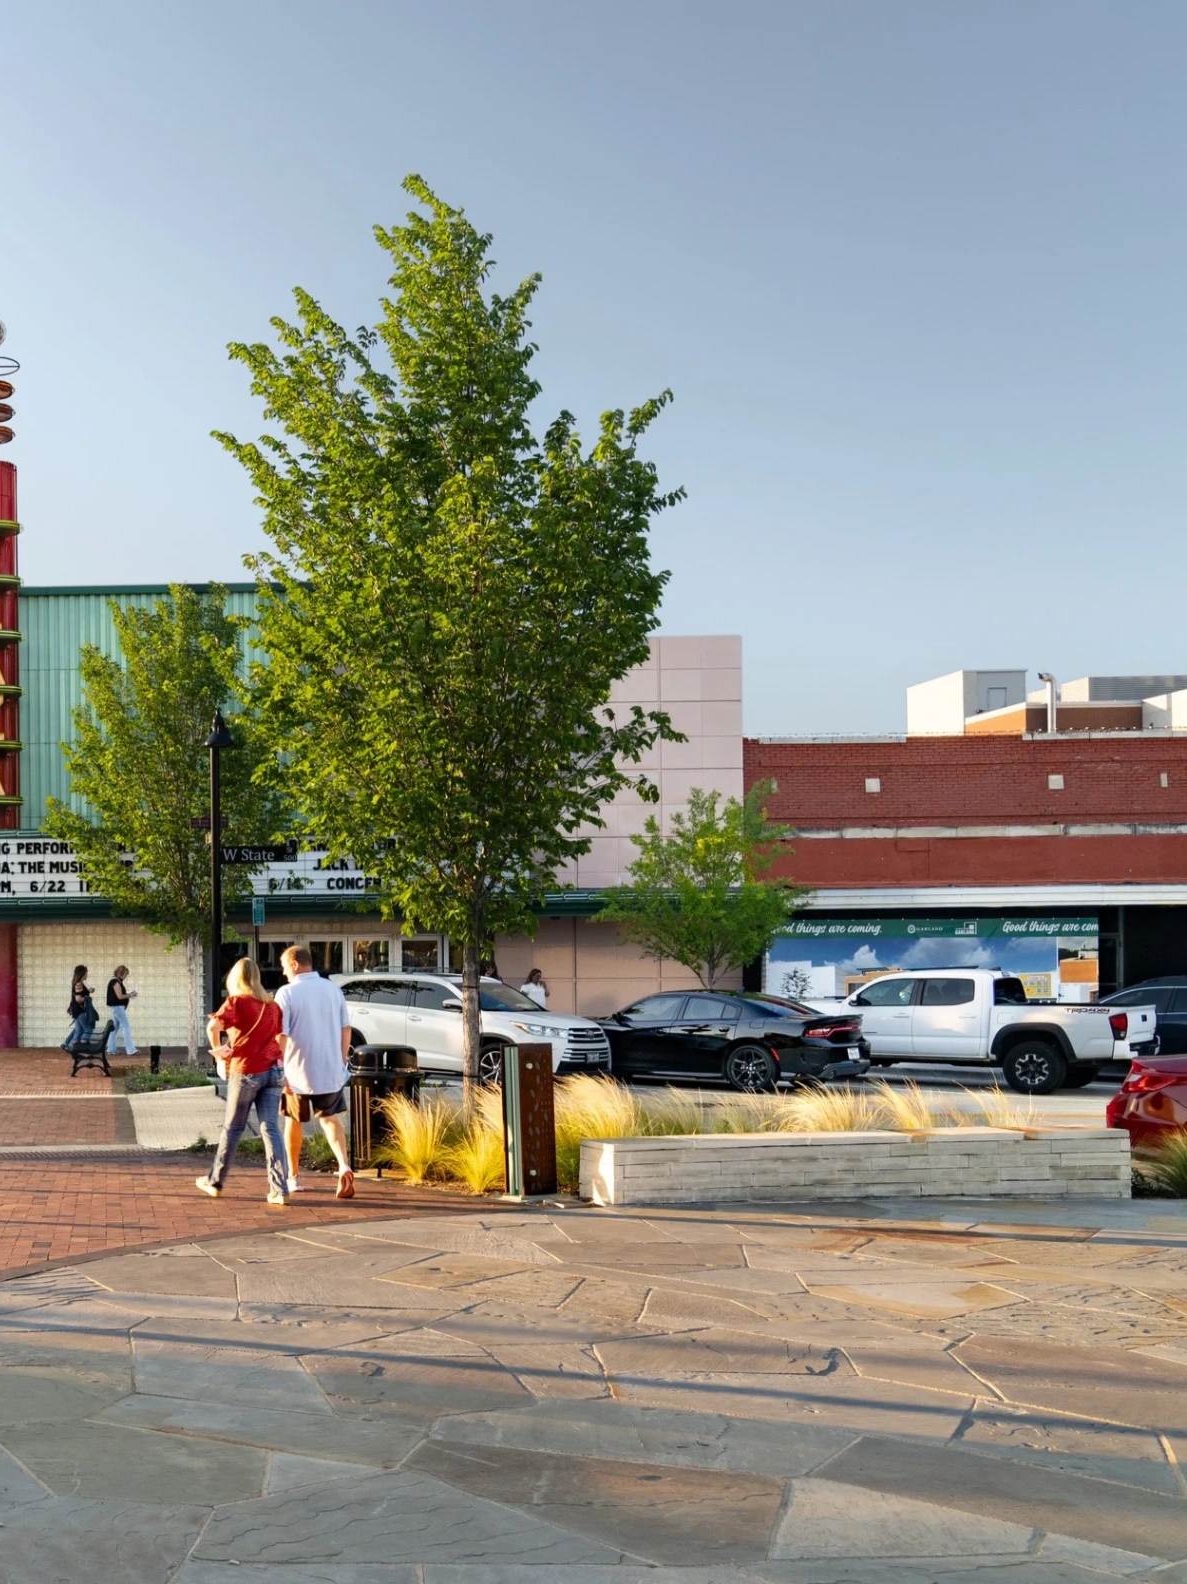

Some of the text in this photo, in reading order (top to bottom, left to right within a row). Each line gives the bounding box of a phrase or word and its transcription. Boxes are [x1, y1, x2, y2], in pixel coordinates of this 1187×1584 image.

[223, 848, 237, 860] W
[241, 848, 275, 860] State
[18, 862, 44, 873] THE
[30, 880, 66, 893] 6/22
[796, 922, 826, 936] things
[828, 924, 846, 933] are
[848, 923, 882, 936] coming.
[1002, 921, 1028, 934] Good
[1029, 921, 1060, 935] things
[1062, 924, 1080, 932] are
